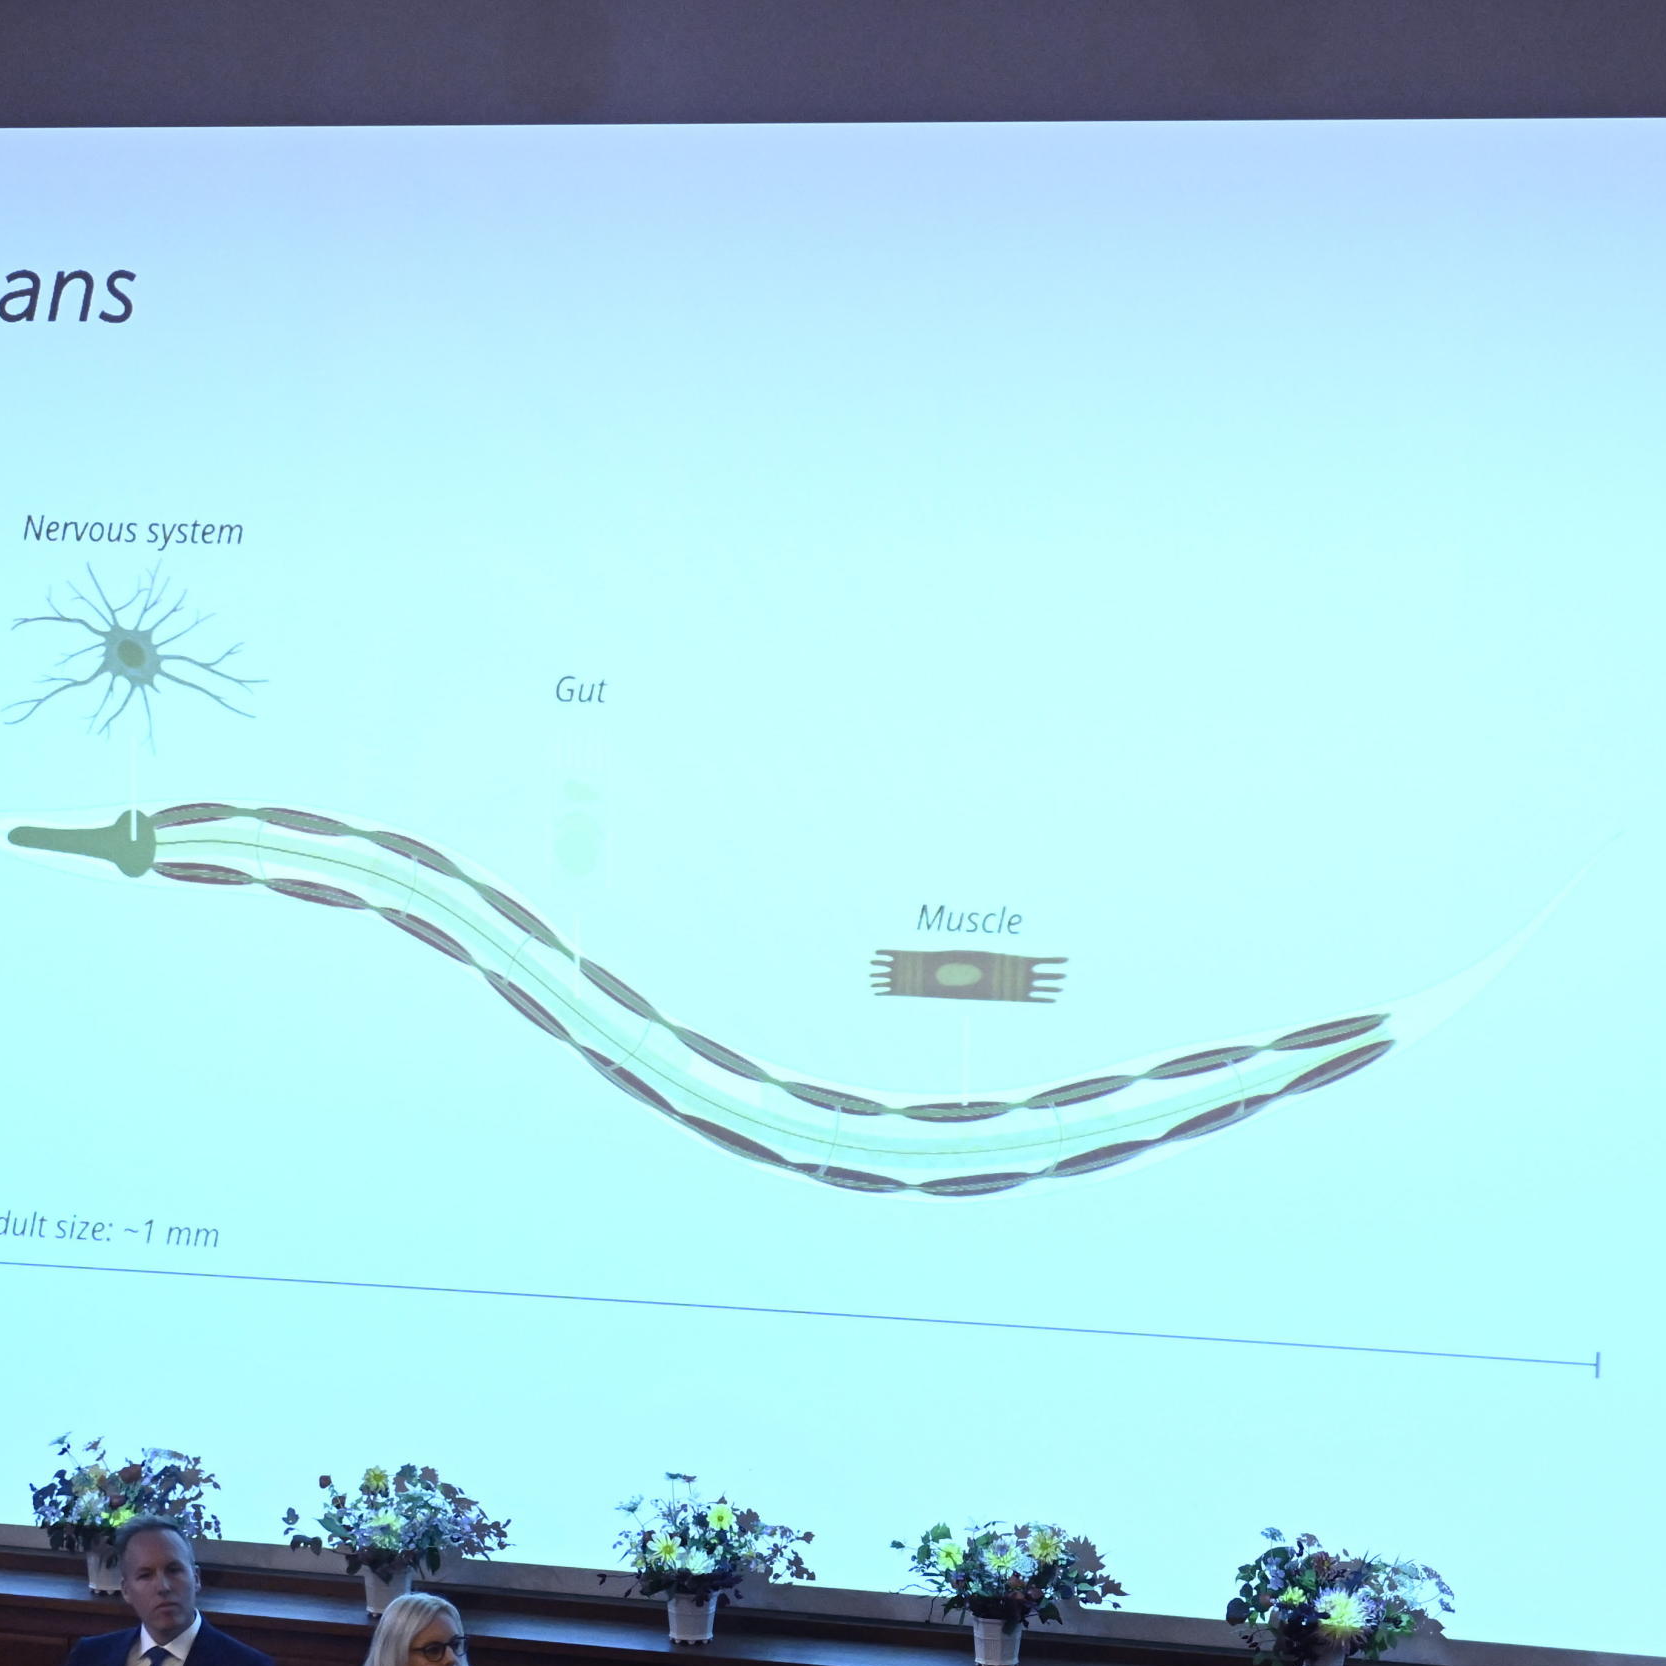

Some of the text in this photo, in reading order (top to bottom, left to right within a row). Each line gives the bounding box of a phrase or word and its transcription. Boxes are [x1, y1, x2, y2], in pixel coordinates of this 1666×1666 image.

[23, 513, 244, 552] Nervous system
[555, 674, 609, 704] Gut
[916, 903, 1023, 935] Muscle
[54, 1213, 114, 1242] size:
[165, 1225, 220, 1248] mm
